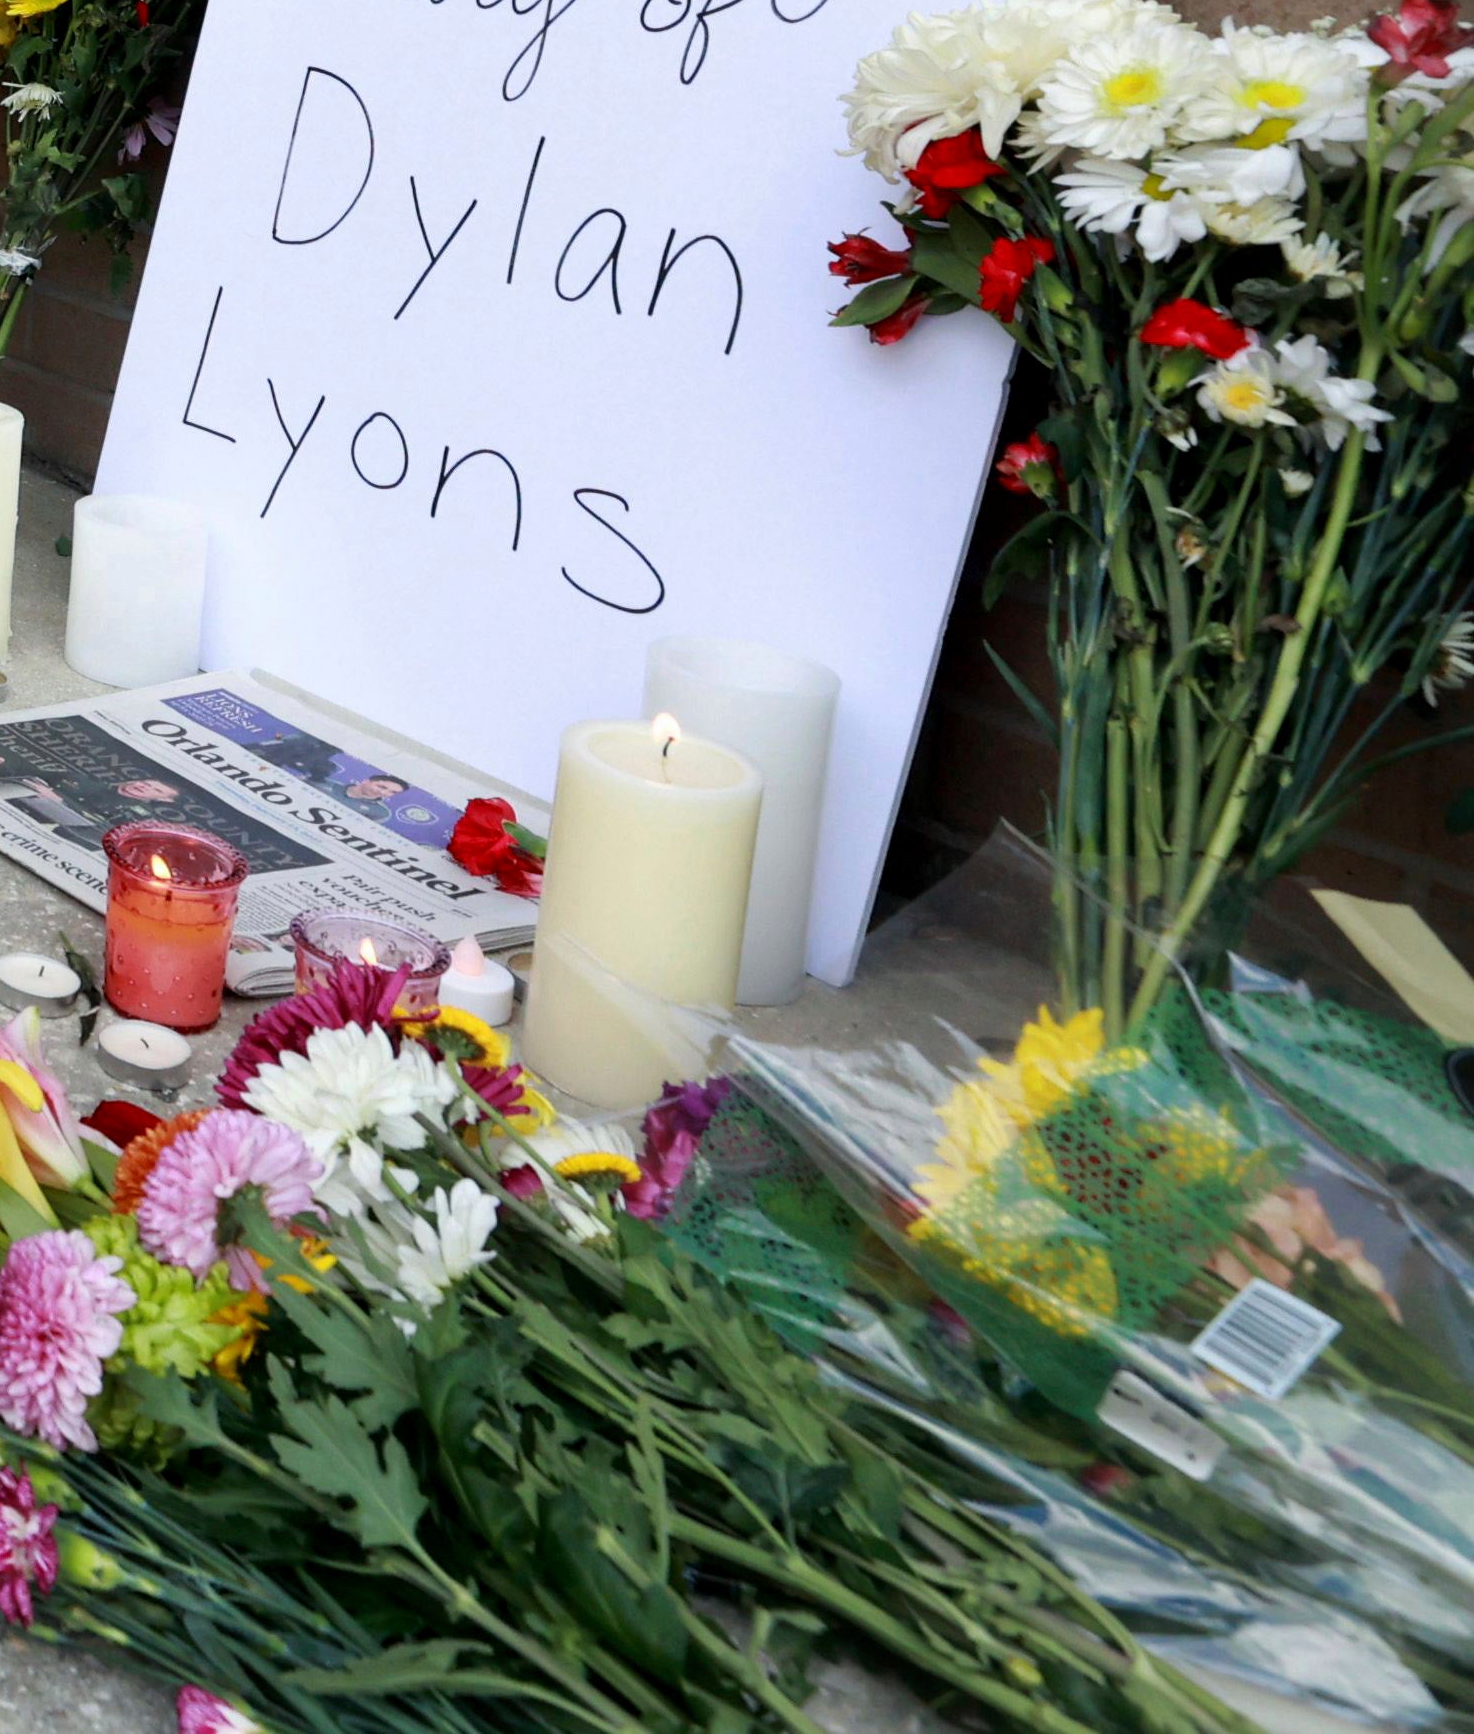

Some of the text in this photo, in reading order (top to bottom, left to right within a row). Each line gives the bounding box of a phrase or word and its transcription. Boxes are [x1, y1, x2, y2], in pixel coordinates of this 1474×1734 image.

[272, 65, 745, 355] Dylan
[183, 286, 665, 614] Lyons
[1, 828, 59, 863] crime
[142, 720, 293, 806] Orlando
[288, 807, 487, 901] Sentinel
[342, 874, 386, 896] Pair
[373, 896, 436, 922] push
